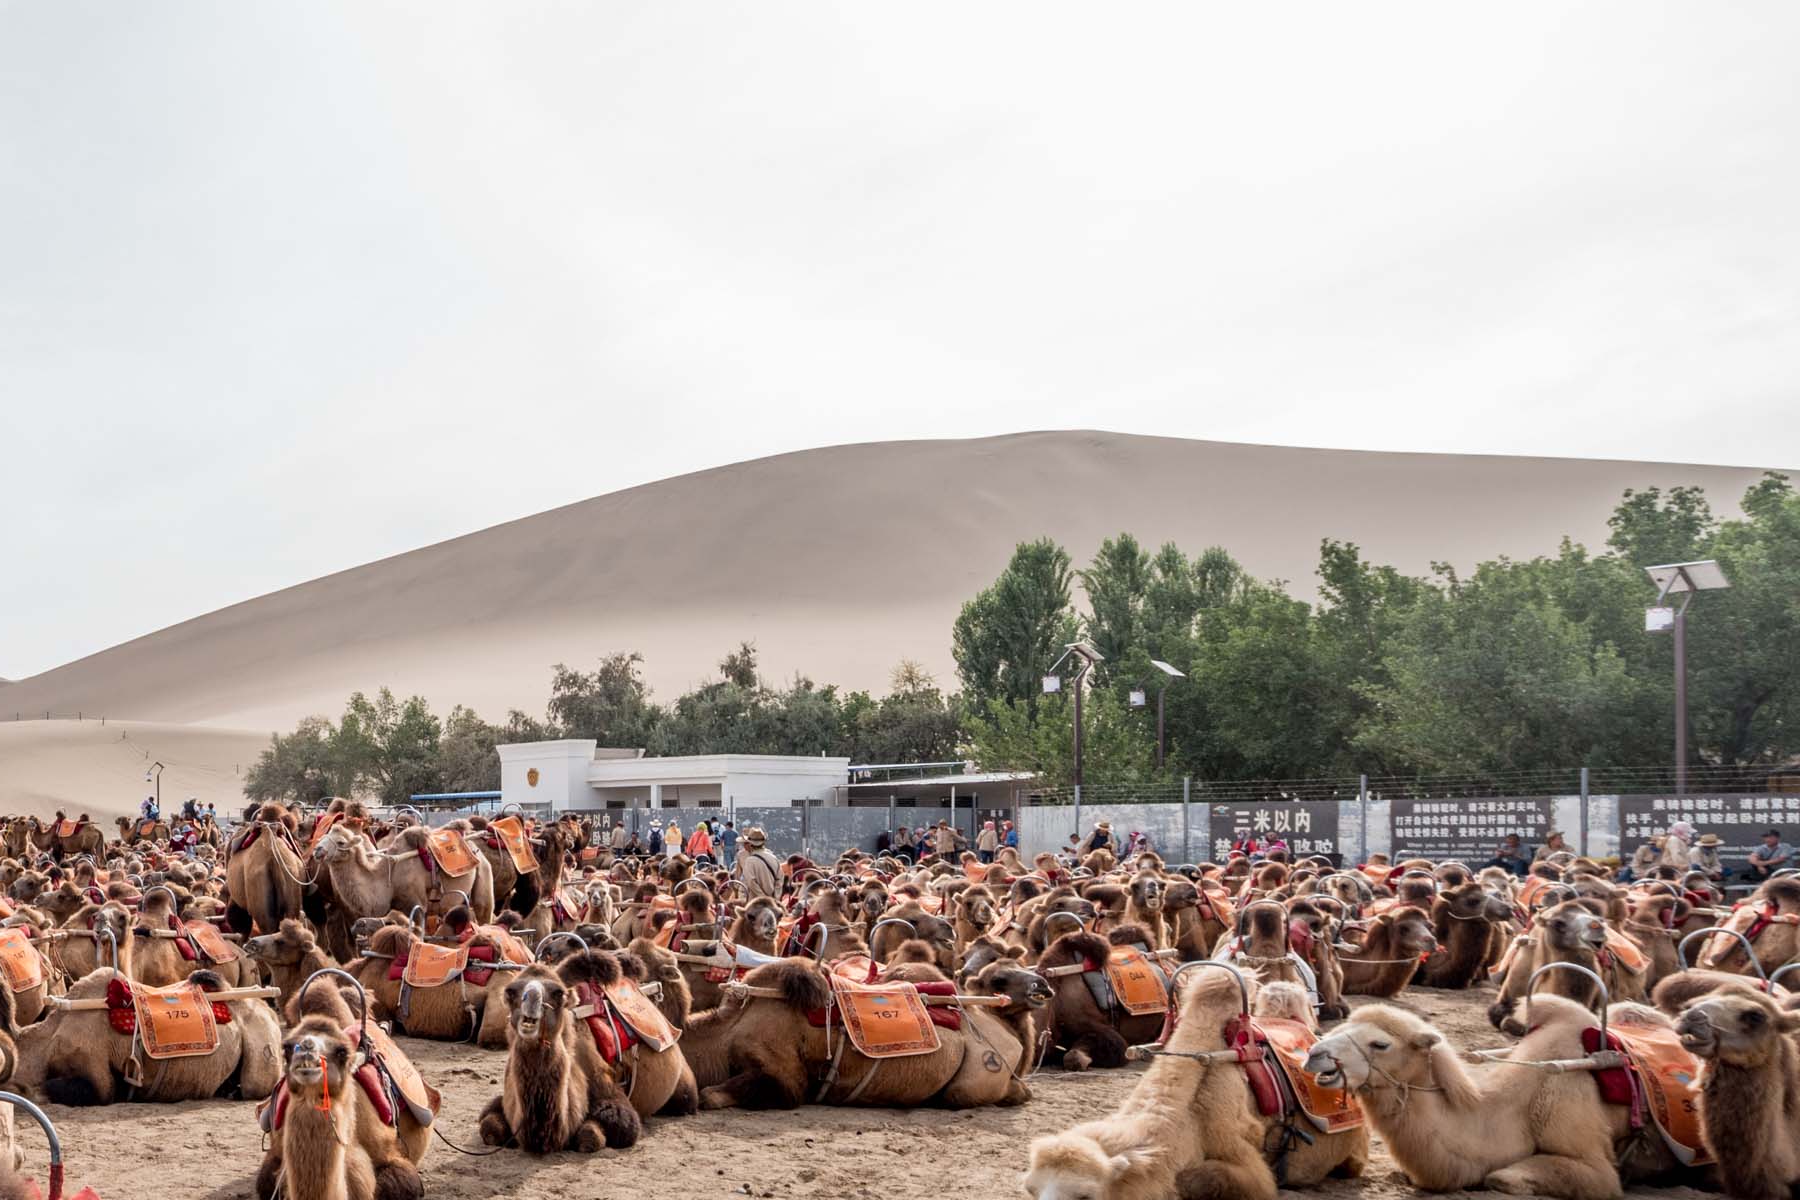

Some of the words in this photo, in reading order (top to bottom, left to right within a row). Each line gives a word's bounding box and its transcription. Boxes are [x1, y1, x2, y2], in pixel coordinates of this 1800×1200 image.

[1234, 809, 1311, 833] 三米以内
[166, 1009, 189, 1020] 175
[872, 1010, 899, 1019] 167
